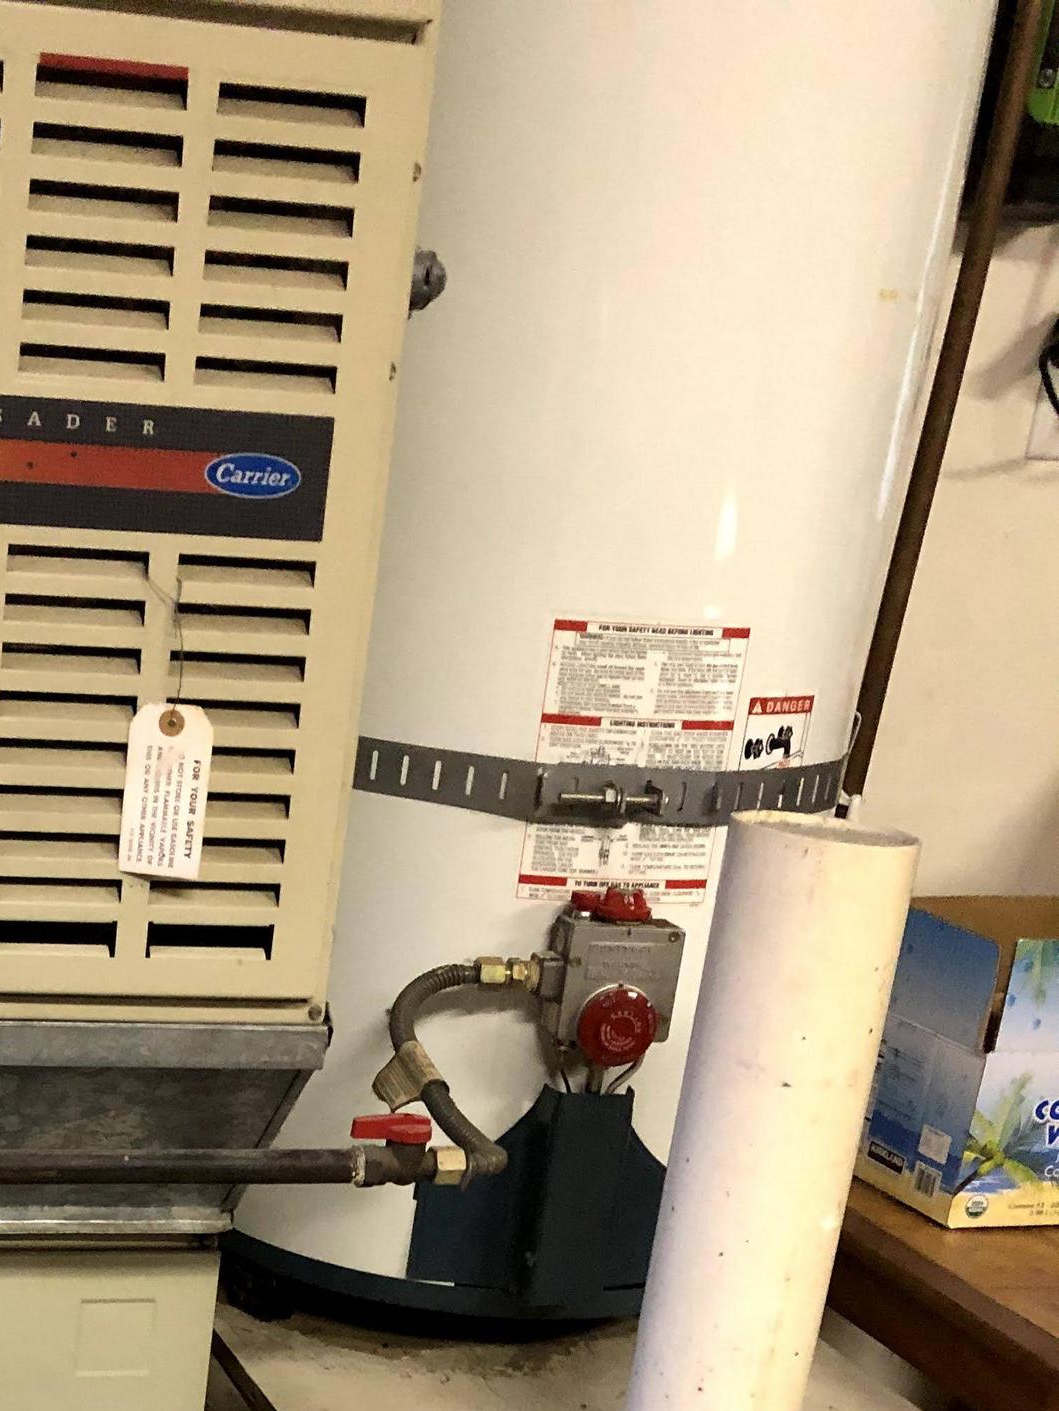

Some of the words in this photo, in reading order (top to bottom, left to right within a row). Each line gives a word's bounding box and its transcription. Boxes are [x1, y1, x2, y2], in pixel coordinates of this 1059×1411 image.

[215, 462, 292, 487] Carrier
[765, 699, 811, 713] DANGER
[192, 760, 202, 780] FOR
[142, 778, 150, 793] ANY
[188, 787, 198, 815] YOUR
[183, 820, 195, 859] SAFETY
